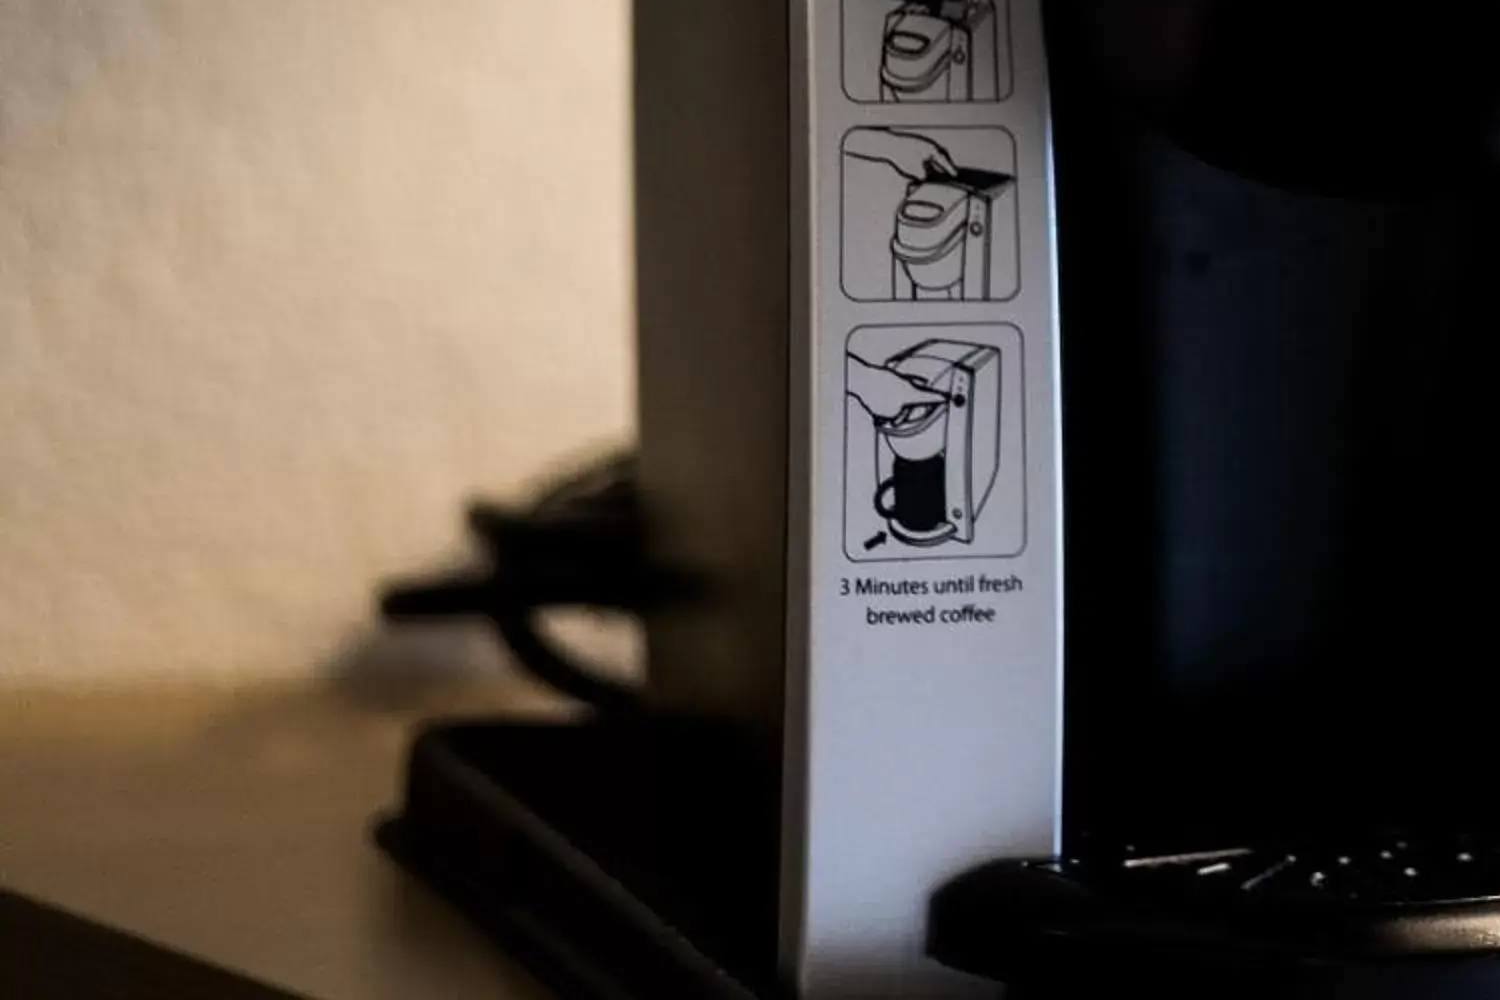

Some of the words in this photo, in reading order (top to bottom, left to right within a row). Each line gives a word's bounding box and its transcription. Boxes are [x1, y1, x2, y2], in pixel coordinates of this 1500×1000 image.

[840, 577, 850, 596] 3
[855, 576, 929, 596] Minutes
[933, 575, 975, 595] until
[978, 573, 1024, 593] fresh
[866, 605, 935, 625] brewed
[939, 603, 997, 623] coffee
